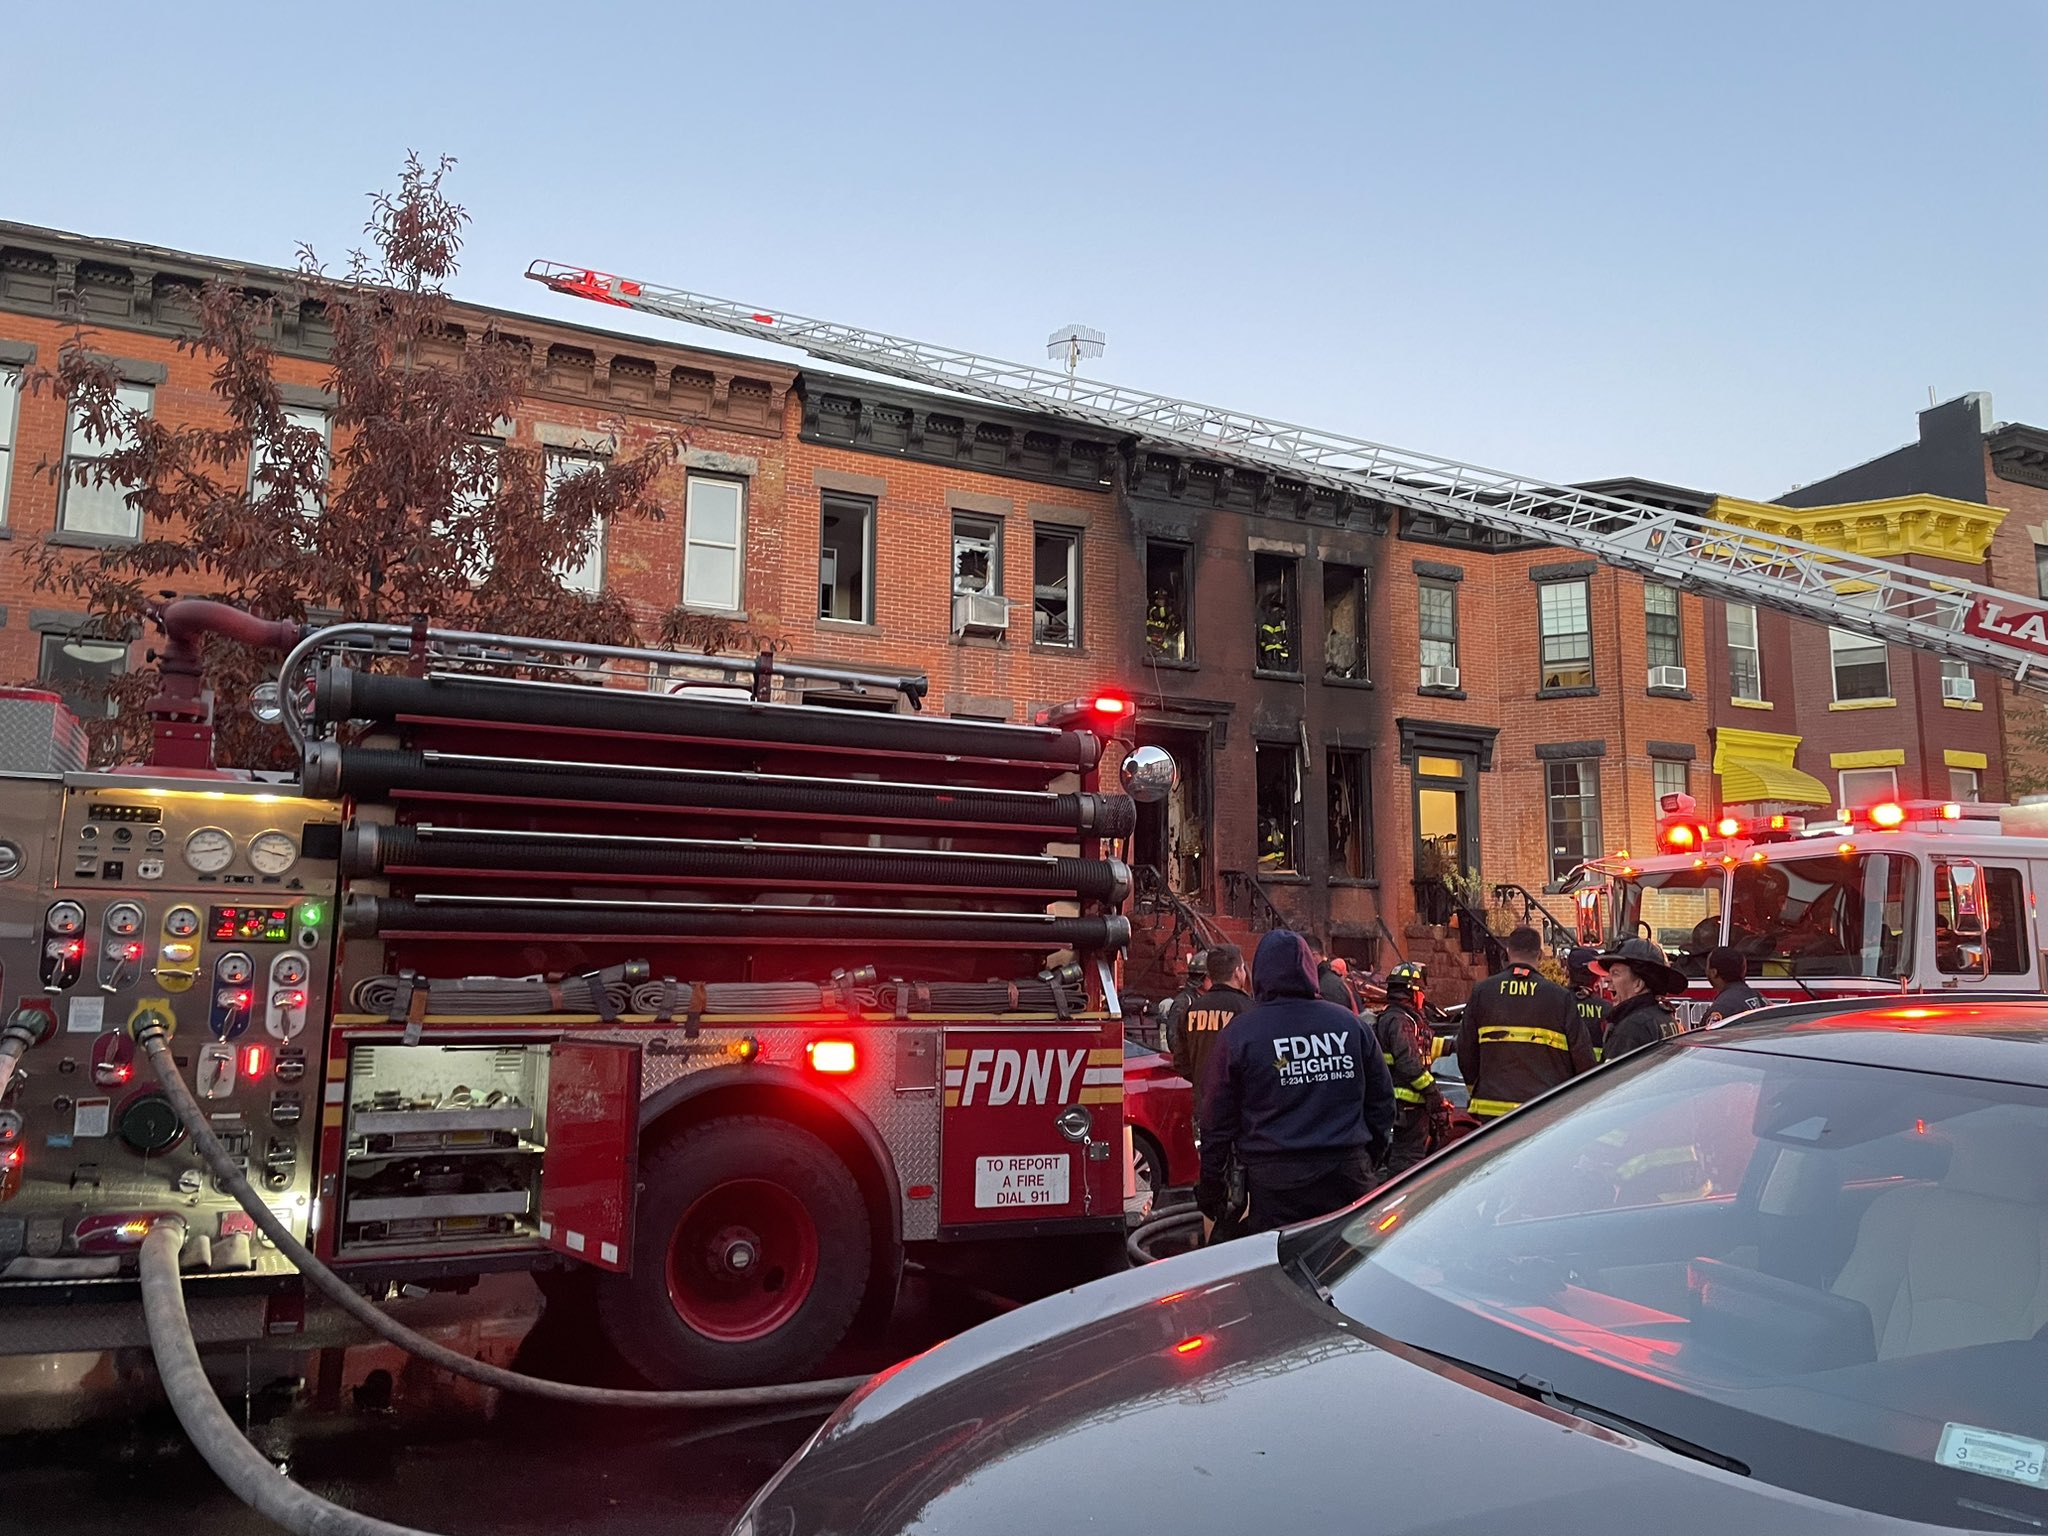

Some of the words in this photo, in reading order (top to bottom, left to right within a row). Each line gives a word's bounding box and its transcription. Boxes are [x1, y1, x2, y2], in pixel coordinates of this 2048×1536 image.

[1500, 980, 1538, 996] FDNY
[1577, 1003, 1602, 1018] DNY
[1188, 1010, 1235, 1032] FDNY
[1273, 1031, 1349, 1061] FDNY
[1279, 1055, 1354, 1077] HEIGHTS
[961, 1048, 1087, 1106] FDNY
[1280, 1076, 1304, 1086] E-234
[1306, 1073, 1328, 1084] L-123
[986, 1159, 1004, 1172] TO
[1009, 1157, 1061, 1171] REPORT
[1002, 1175, 1011, 1188] A
[1017, 1174, 1044, 1187] FIRE
[997, 1192, 1025, 1204] DIAL
[1031, 1190, 1049, 1203] 911
[1955, 1447, 1968, 1460] 3
[2014, 1459, 2040, 1475] 25
